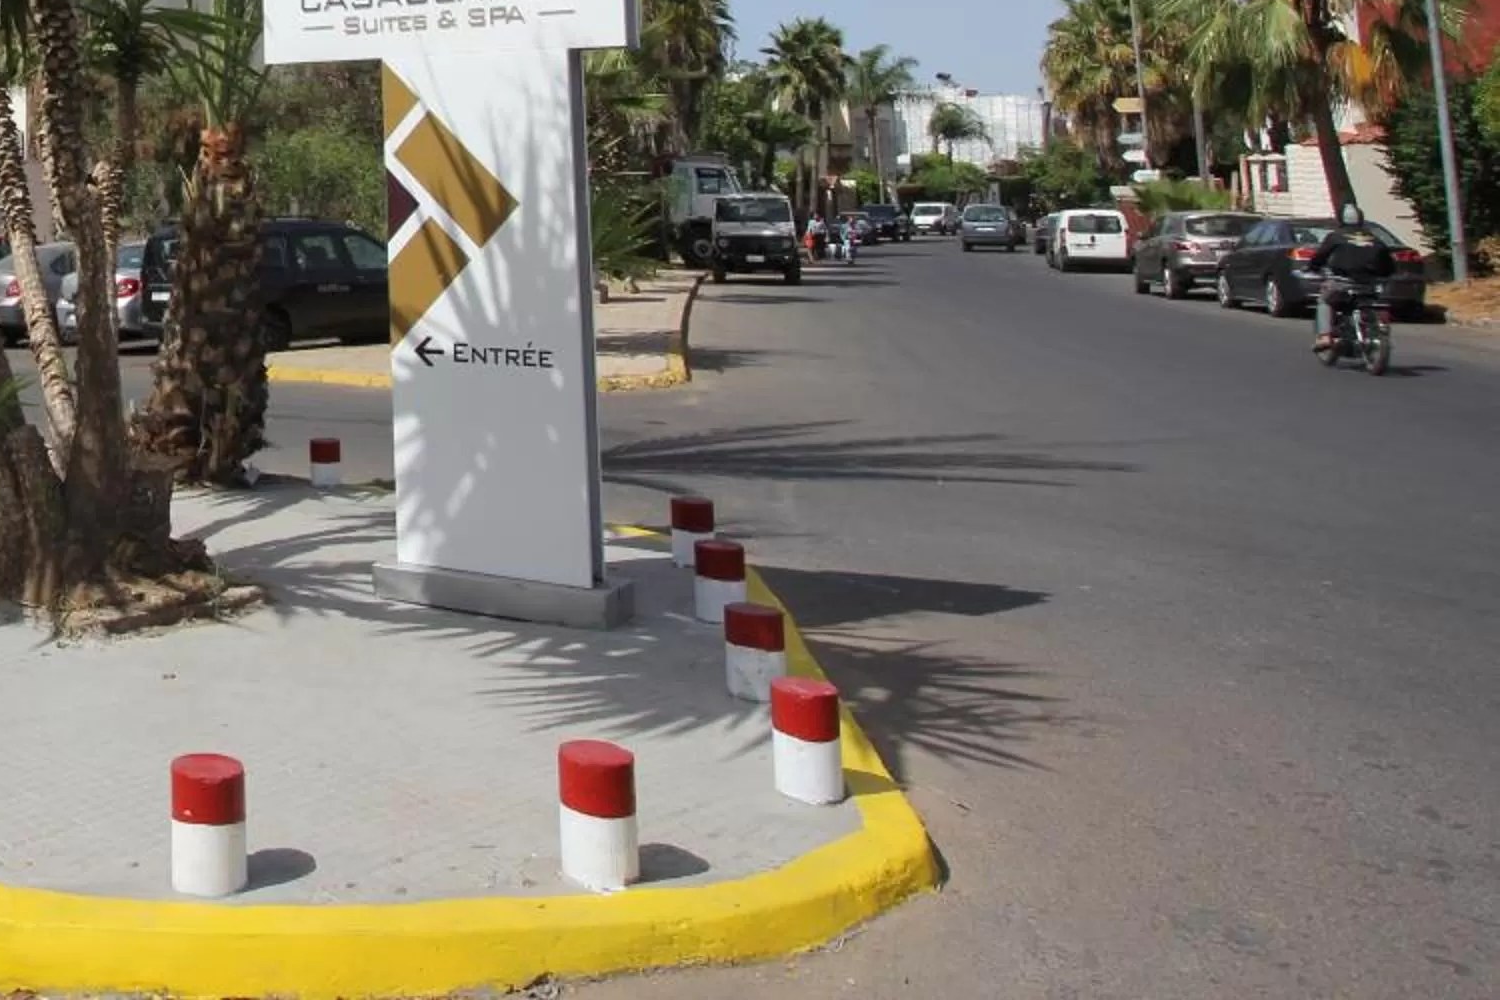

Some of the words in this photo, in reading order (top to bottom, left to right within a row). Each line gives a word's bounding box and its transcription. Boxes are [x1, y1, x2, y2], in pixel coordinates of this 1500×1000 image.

[343, 15, 428, 35] SUITES
[437, 9, 458, 29] &
[467, 5, 526, 27] SPA
[453, 340, 554, 368] ENTRÉE
